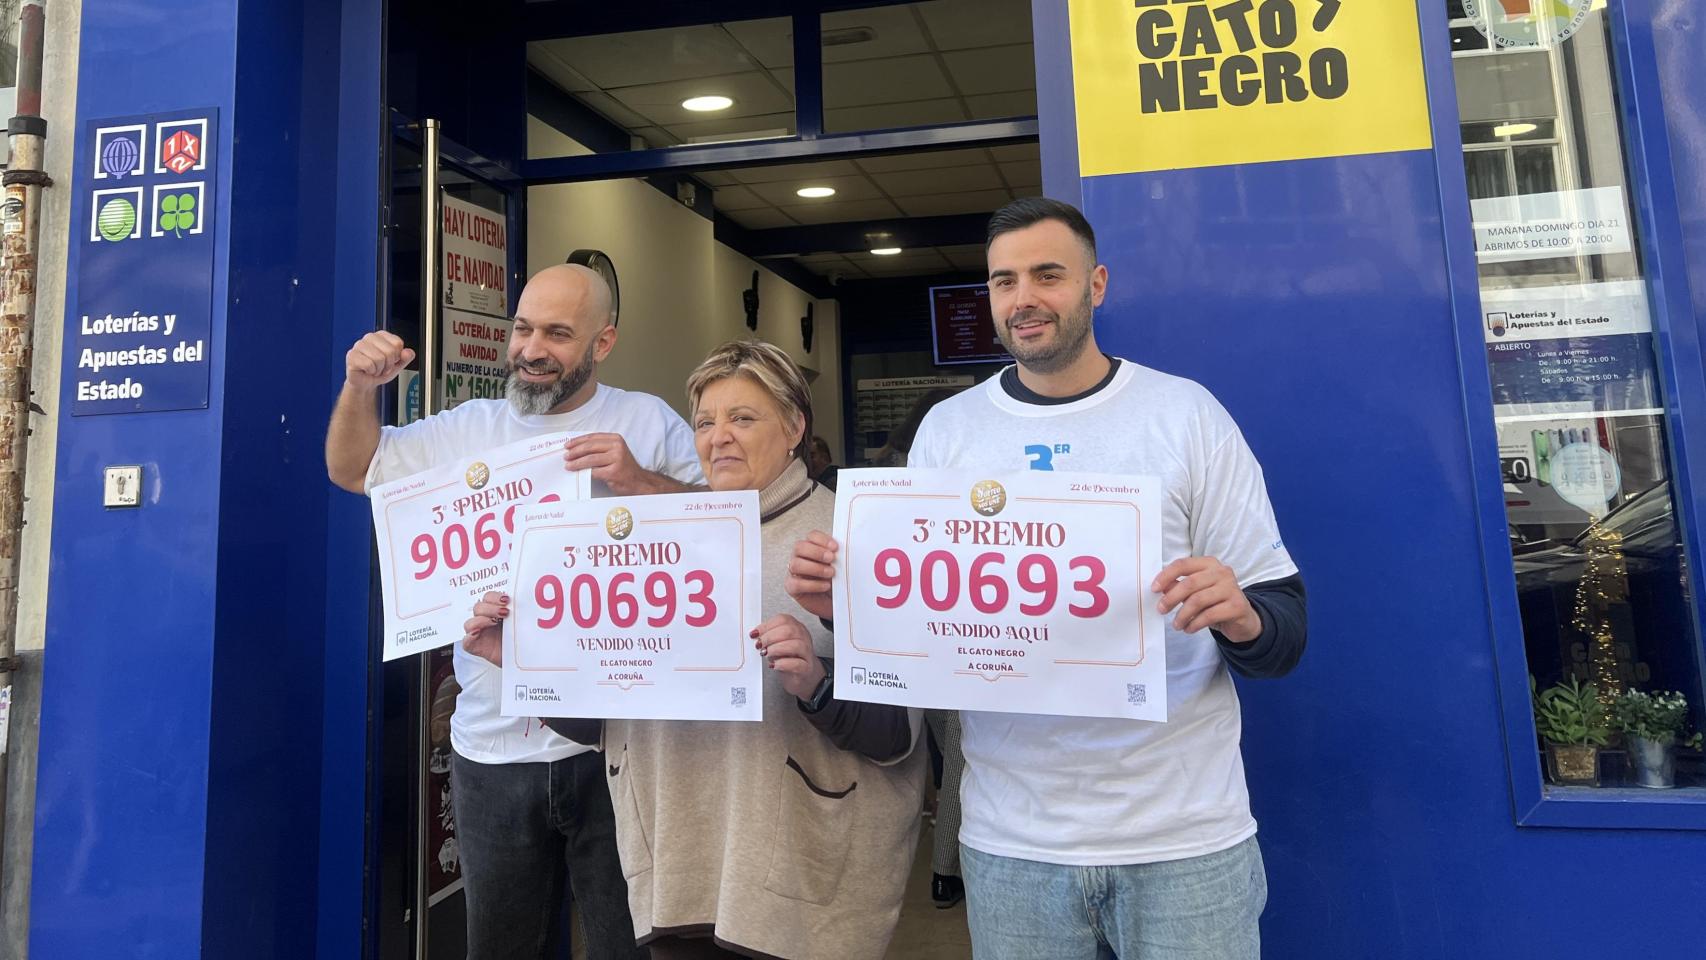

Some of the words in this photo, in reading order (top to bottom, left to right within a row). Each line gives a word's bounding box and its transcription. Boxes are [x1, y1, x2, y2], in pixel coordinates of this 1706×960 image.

[1136, 0, 1297, 60] GATO
[1138, 48, 1349, 114] NEGRO
[444, 205, 464, 238] HAY
[468, 213, 506, 252] LOTERIA
[1488, 225, 1532, 236] MAÑANA
[1535, 222, 1584, 233] DOMINGO
[1608, 220, 1619, 228] 21
[1484, 240, 1529, 251] ABRIMOS
[1532, 240, 1544, 248] DE
[1547, 238, 1574, 246] 10:00
[1586, 234, 1612, 244] 20:00
[447, 252, 461, 282] DE
[464, 256, 504, 292] NAVIDAD
[82, 311, 158, 335] Loterías
[164, 314, 176, 336] y
[1509, 311, 1548, 320] Loterías
[1510, 319, 1554, 330] Apuestas
[1576, 316, 1610, 324] Estado
[453, 320, 491, 340] LOTERÍA
[494, 328, 506, 342] DE
[79, 345, 166, 372] Apuestas
[172, 340, 202, 362] del
[460, 343, 498, 361] NAVIDAD
[1494, 342, 1530, 351] ABIERTO
[446, 360, 473, 374] NUMERO
[475, 364, 482, 375] DE
[484, 366, 490, 376] LA
[78, 378, 142, 400] Estado
[446, 374, 463, 398] Nº
[453, 478, 533, 517] PREMIO
[1082, 484, 1092, 492] de
[1093, 484, 1140, 494] Decembro
[704, 501, 743, 512] Decembro
[944, 520, 1066, 548] PREMIO
[588, 542, 682, 568] PREMIO
[450, 565, 498, 588] VENDIDO
[874, 548, 1110, 618] 90693
[478, 584, 494, 594] GATO
[534, 570, 718, 630] 90693
[927, 621, 1001, 639] VENDIDO
[1005, 624, 1049, 644] AQUÍ
[576, 637, 634, 651] VENDIDO
[638, 634, 672, 653] AQUÍ
[958, 647, 968, 655] EL
[970, 648, 992, 656] GATO
[994, 649, 1025, 658] NEGRO
[614, 672, 644, 680] CORUÑA
[868, 672, 900, 681] LOTERÍA
[968, 662, 974, 670] A
[976, 662, 1014, 672] CORUÑA
[868, 679, 908, 690] NACIONAL
